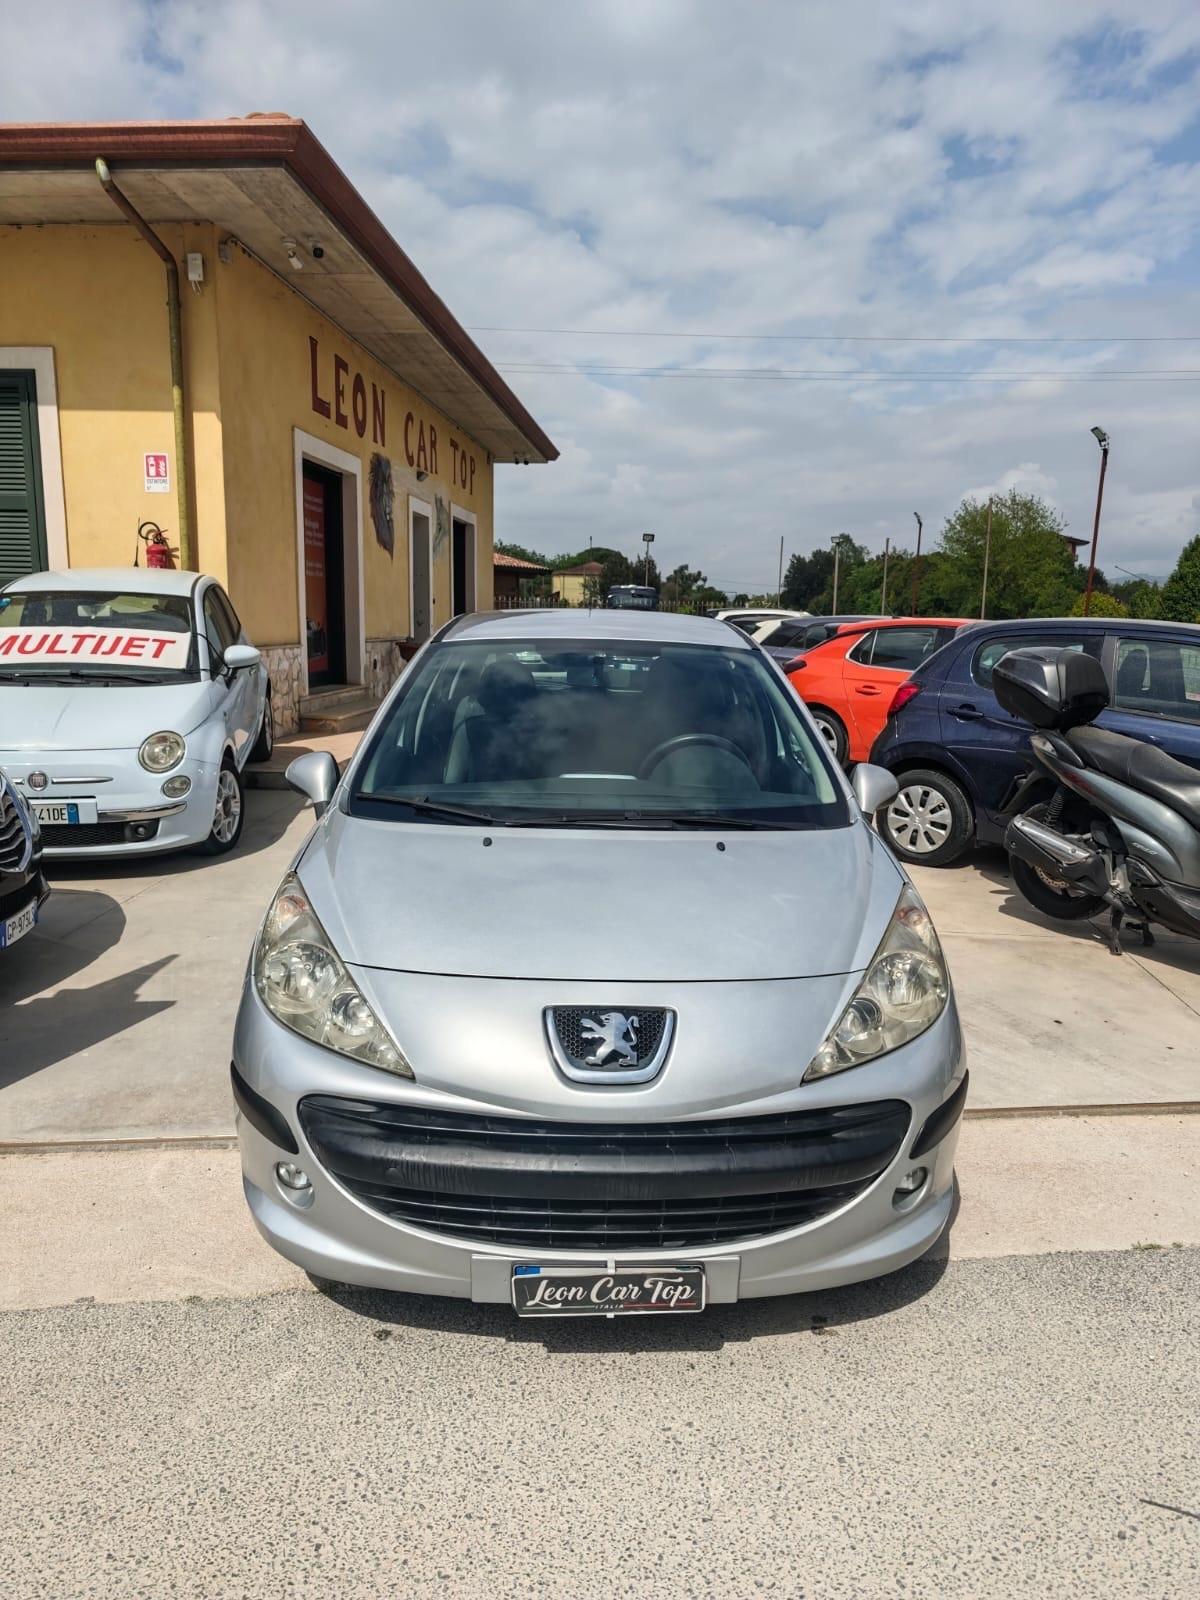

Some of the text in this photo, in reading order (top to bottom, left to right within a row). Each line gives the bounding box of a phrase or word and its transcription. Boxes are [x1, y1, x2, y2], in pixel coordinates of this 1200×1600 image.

[309, 336, 476, 495] LEON CAR TOP
[0, 633, 176, 659] MULTIJET
[33, 807, 67, 821] 41DE
[526, 1276, 696, 1309] Leon Car Top
